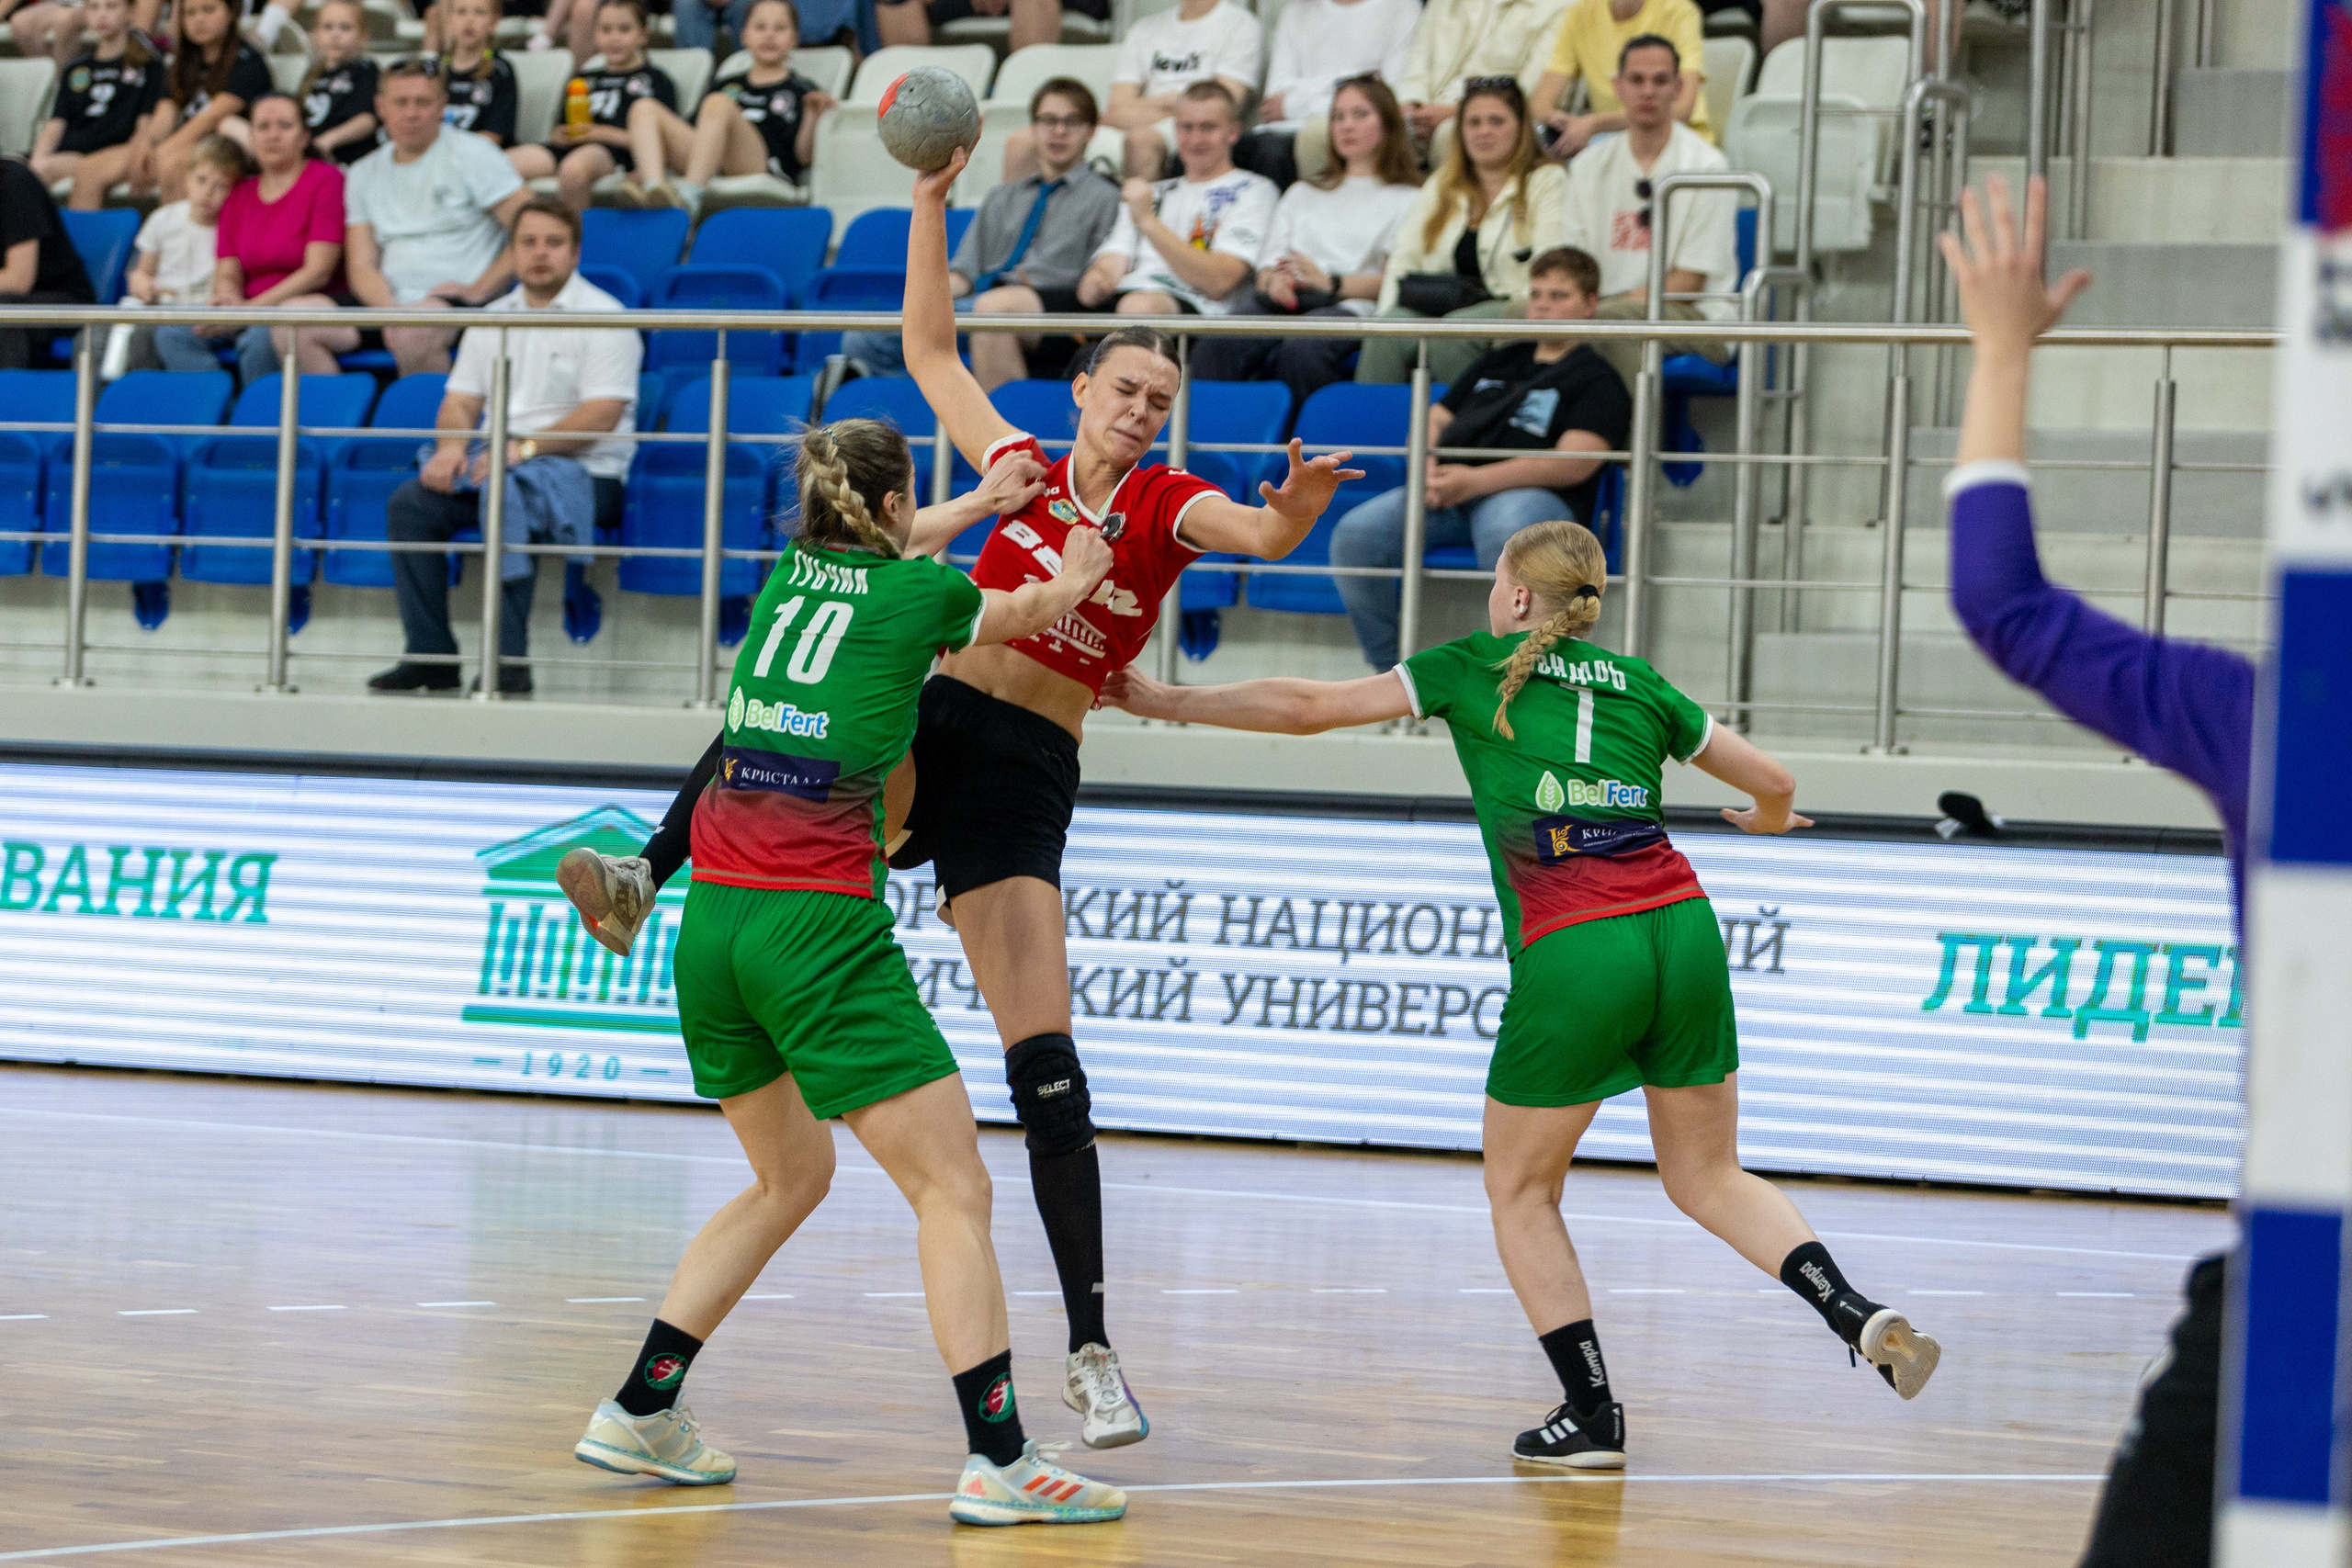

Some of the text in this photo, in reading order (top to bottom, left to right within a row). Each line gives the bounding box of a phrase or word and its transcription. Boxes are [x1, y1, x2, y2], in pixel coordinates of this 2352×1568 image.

[752, 594, 854, 685] 10
[745, 698, 830, 739] BelFert
[1559, 681, 1595, 763] 1
[1567, 779, 1648, 807] BelFert
[0, 840, 278, 922] ВАНИЯ
[1220, 973, 1508, 1038] УНИВЕРС
[520, 1050, 621, 1080] 1920
[1036, 1078, 1070, 1096] SELECT
[1799, 1260, 1836, 1303] Kempa
[1578, 1340, 1607, 1388] Kempa
